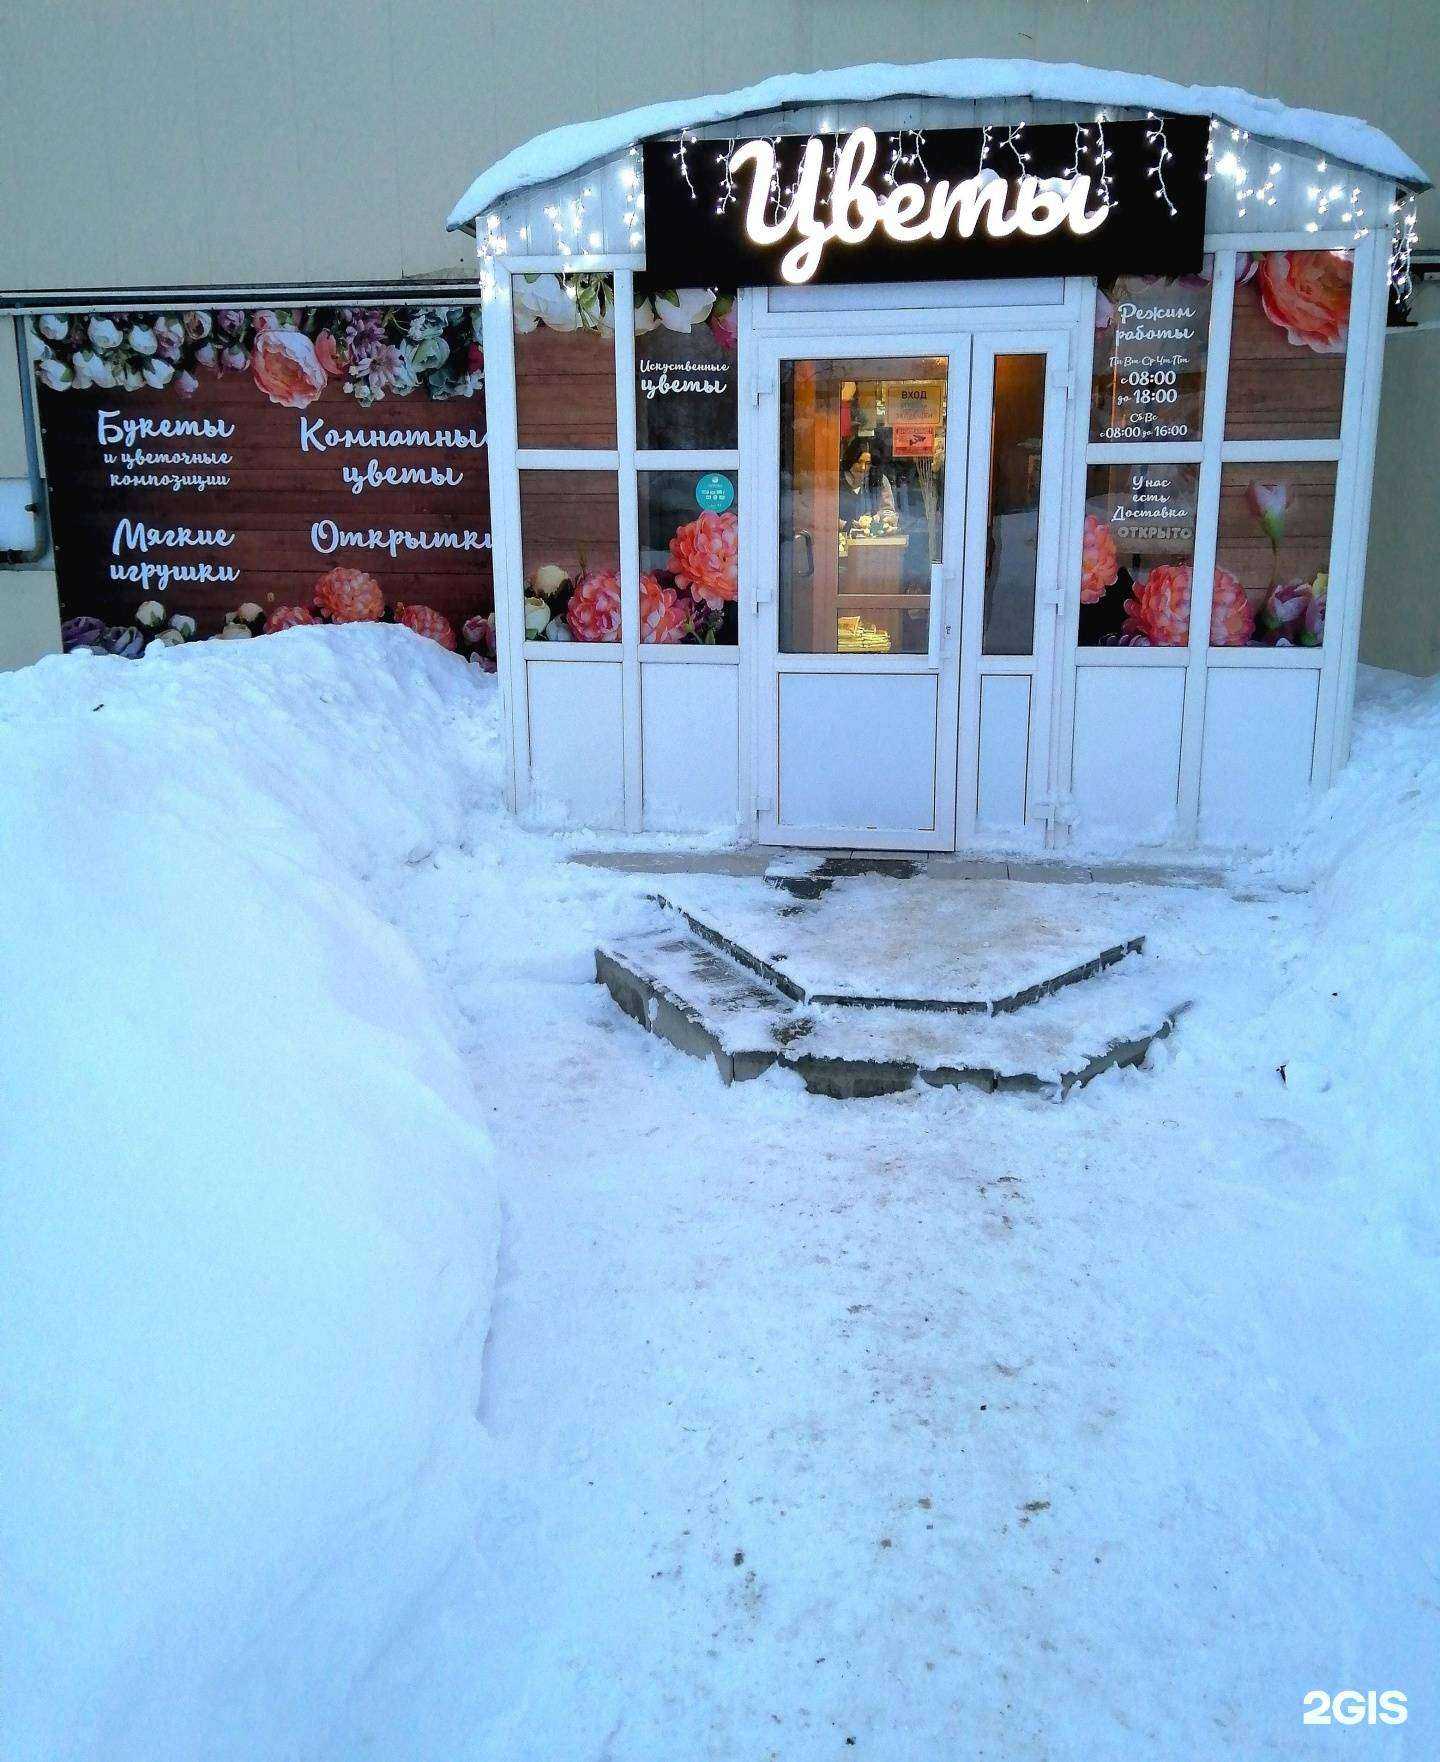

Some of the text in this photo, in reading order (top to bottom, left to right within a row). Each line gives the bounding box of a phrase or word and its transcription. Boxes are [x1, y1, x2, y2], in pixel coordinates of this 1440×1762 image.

[728, 126, 1111, 284] Цветы
[1118, 302, 1197, 324] Режим
[1115, 325, 1195, 347] работы
[640, 359, 730, 374] Искуственные
[641, 373, 727, 400] цветы
[1129, 370, 1177, 386] 08:00
[1133, 388, 1178, 404] 18:00
[97, 409, 235, 447] Букеты
[300, 416, 488, 452] Комнатны
[1106, 426, 1141, 439] 08:00
[1154, 424, 1188, 437] 16:00
[104, 448, 233, 470] и цветочные
[109, 473, 231, 492] композиции
[342, 458, 464, 495] цветы
[1132, 475, 1172, 490] У нас
[1132, 494, 1171, 504] есть
[1111, 505, 1188, 522] Доставка
[112, 518, 236, 556] Мягкие
[1117, 526, 1193, 539] ОТКРЫТО
[109, 562, 241, 591] игрушки
